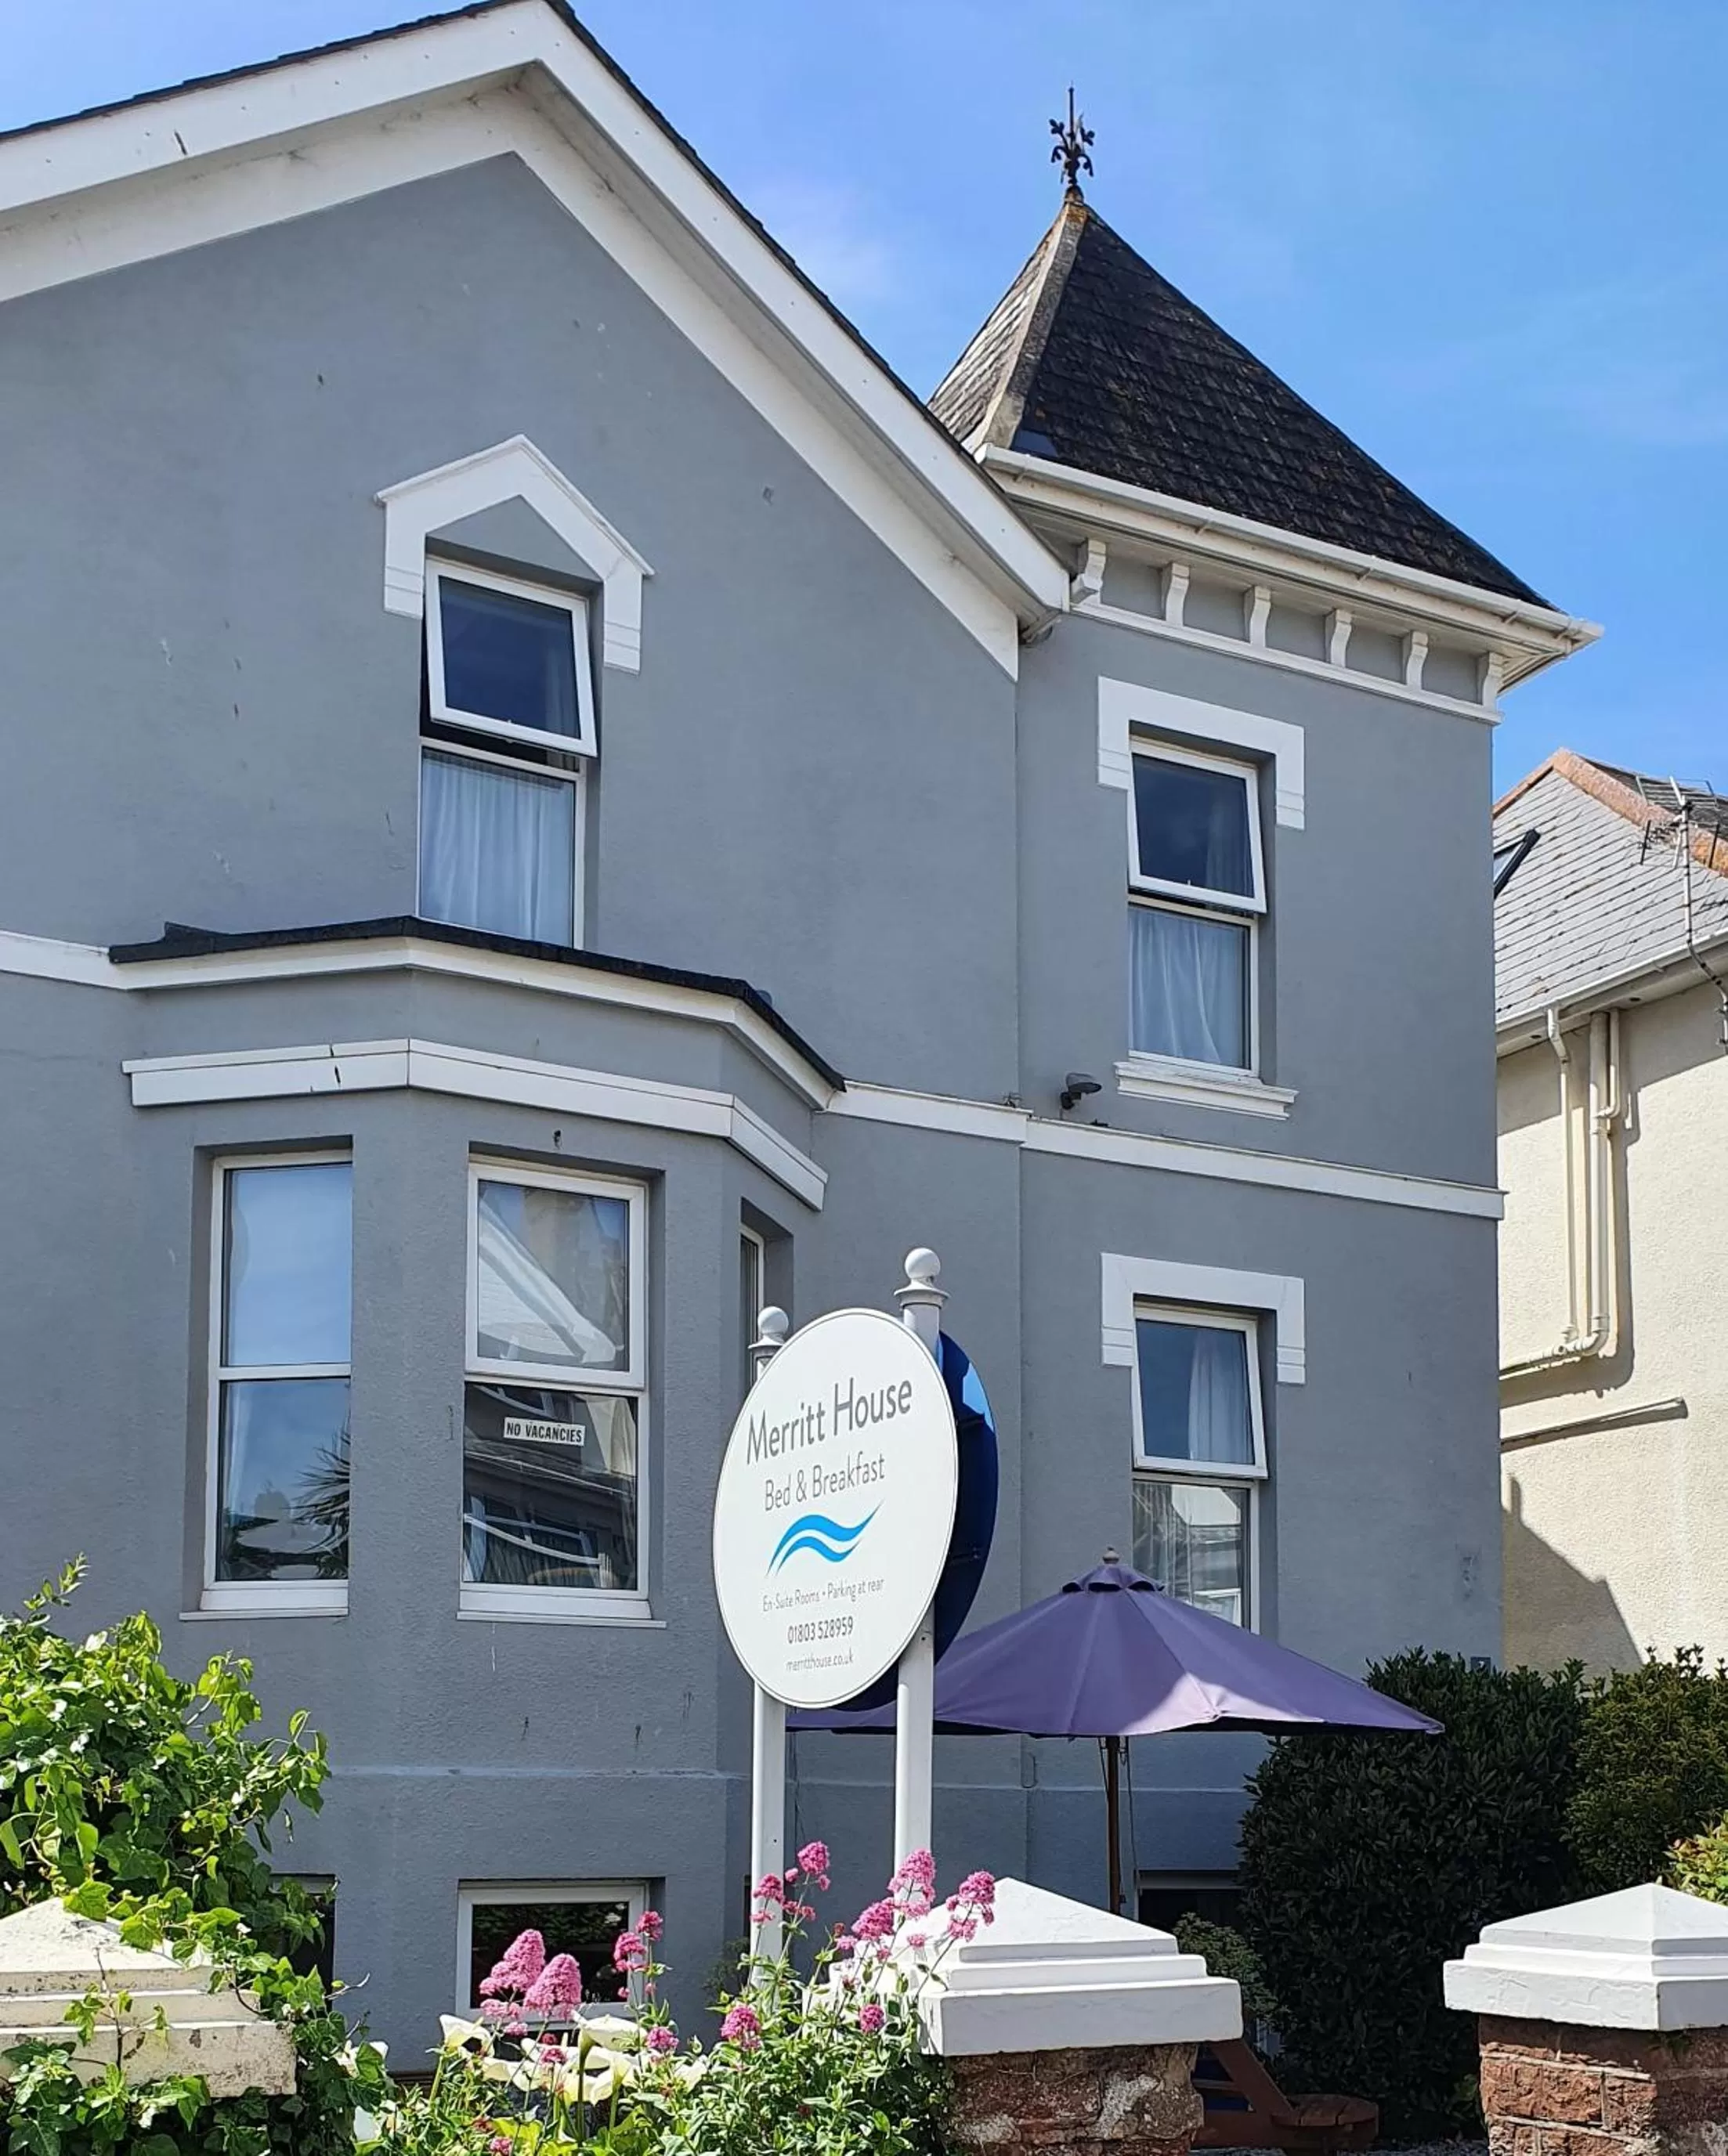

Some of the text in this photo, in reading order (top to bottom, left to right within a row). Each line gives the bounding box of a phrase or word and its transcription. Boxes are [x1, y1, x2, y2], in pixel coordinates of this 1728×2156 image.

[507, 1423, 582, 1443] NO VACANCIES
[747, 1377, 913, 1464] Merritt House
[765, 1450, 885, 1511] Bed & Breakfast
[794, 1589, 820, 1605] Rooms
[827, 1579, 856, 1602] Parking
[858, 1581, 866, 1594] at
[868, 1579, 884, 1592] rear
[787, 1616, 853, 1644] 01803 528959
